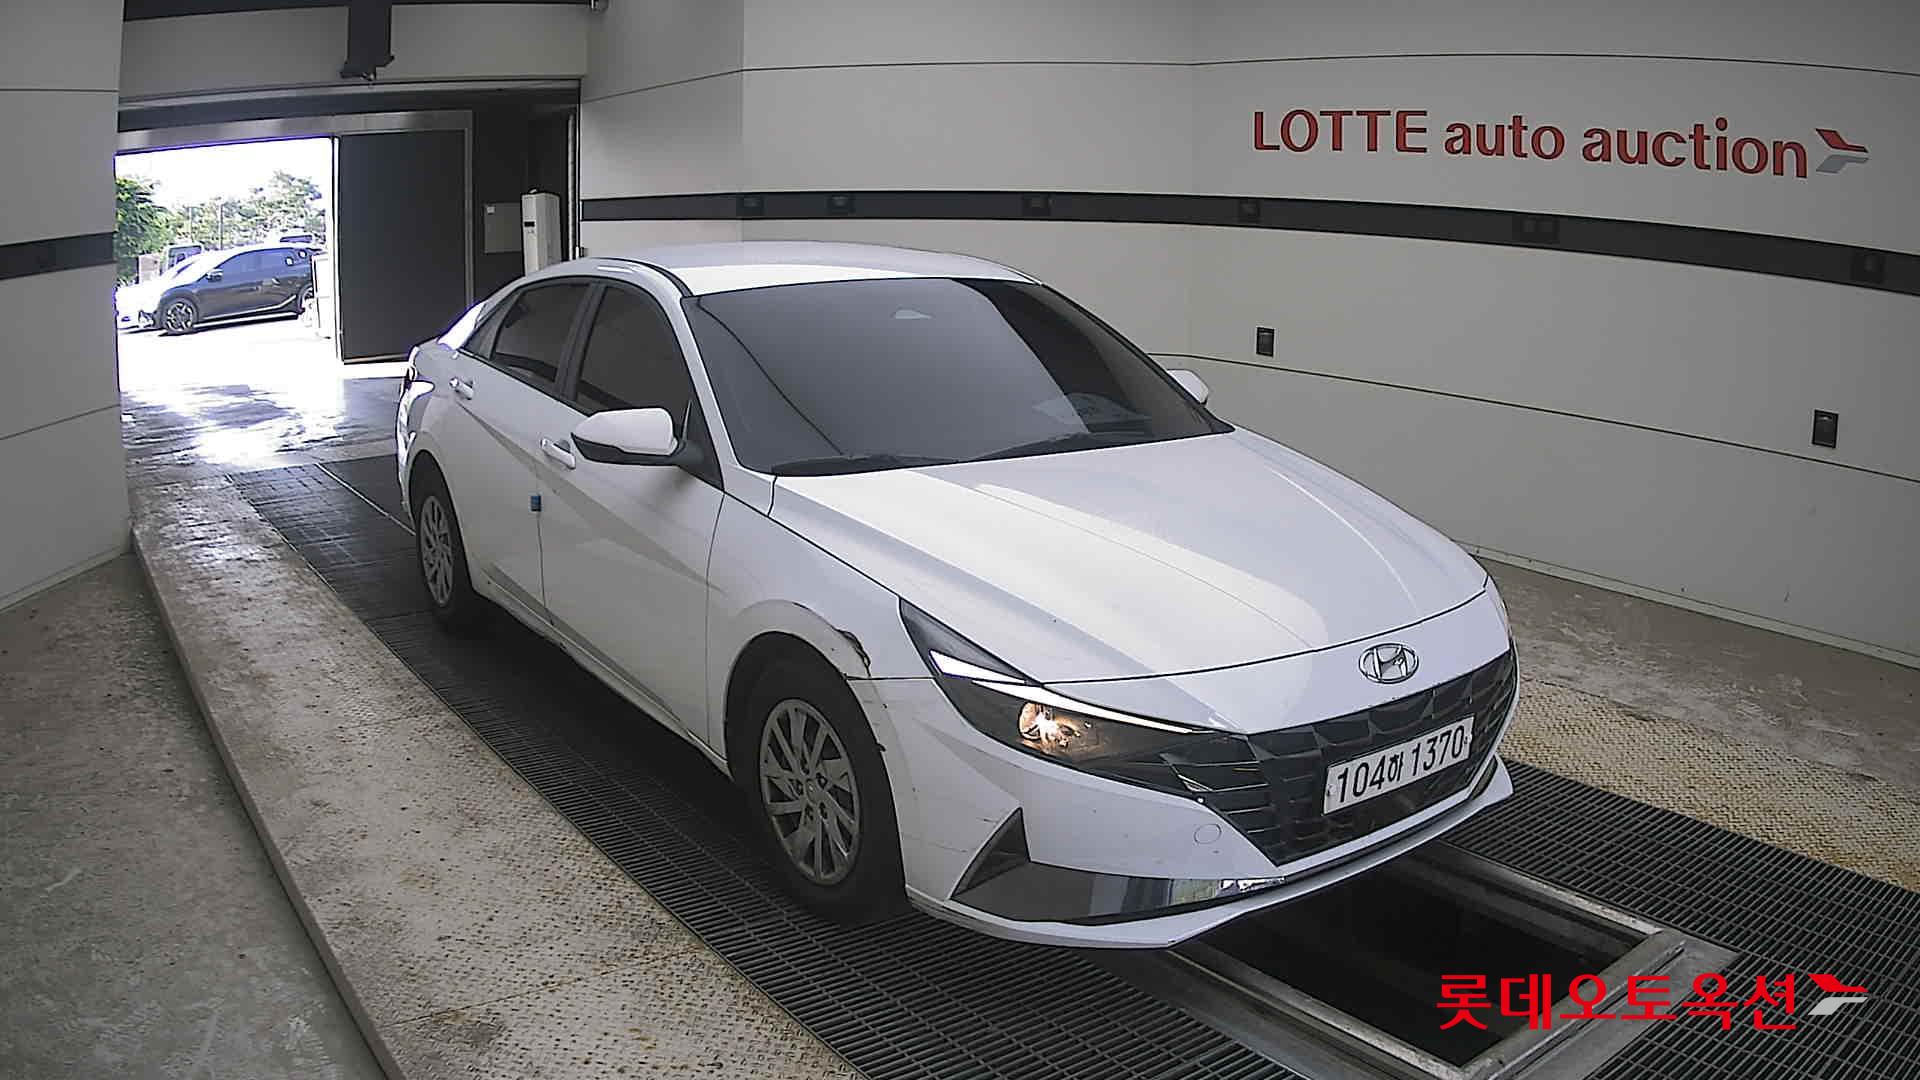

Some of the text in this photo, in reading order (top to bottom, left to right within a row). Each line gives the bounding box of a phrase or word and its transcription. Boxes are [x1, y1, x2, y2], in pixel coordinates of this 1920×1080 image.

[1253, 110, 1808, 179] LOTTE auto auction
[1337, 725, 1466, 802] 104하 1370
